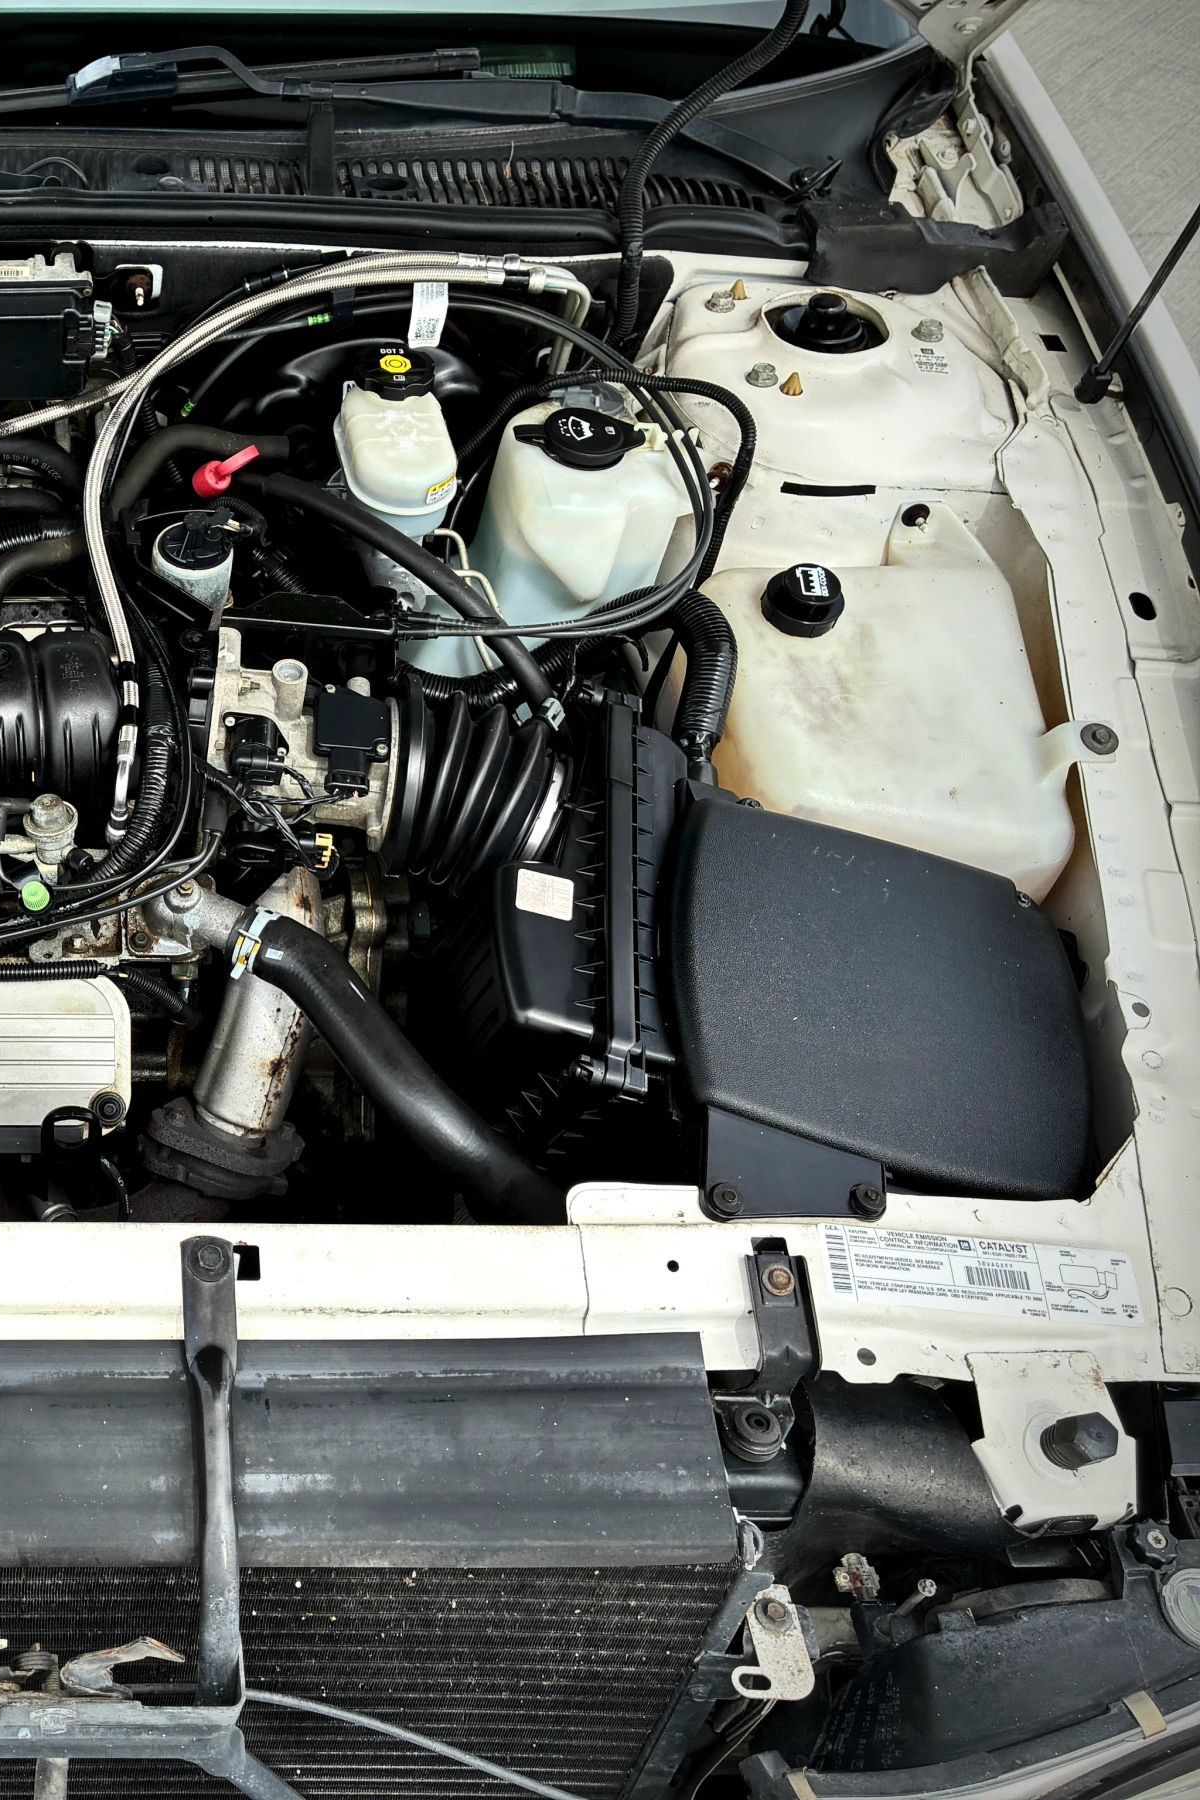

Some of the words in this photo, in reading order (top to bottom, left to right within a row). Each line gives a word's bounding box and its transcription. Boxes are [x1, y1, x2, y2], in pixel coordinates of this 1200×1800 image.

[880, 1236, 911, 1244] CONTROL
[914, 1240, 958, 1249] INFORMATION
[979, 1241, 1028, 1253] CATALYST
